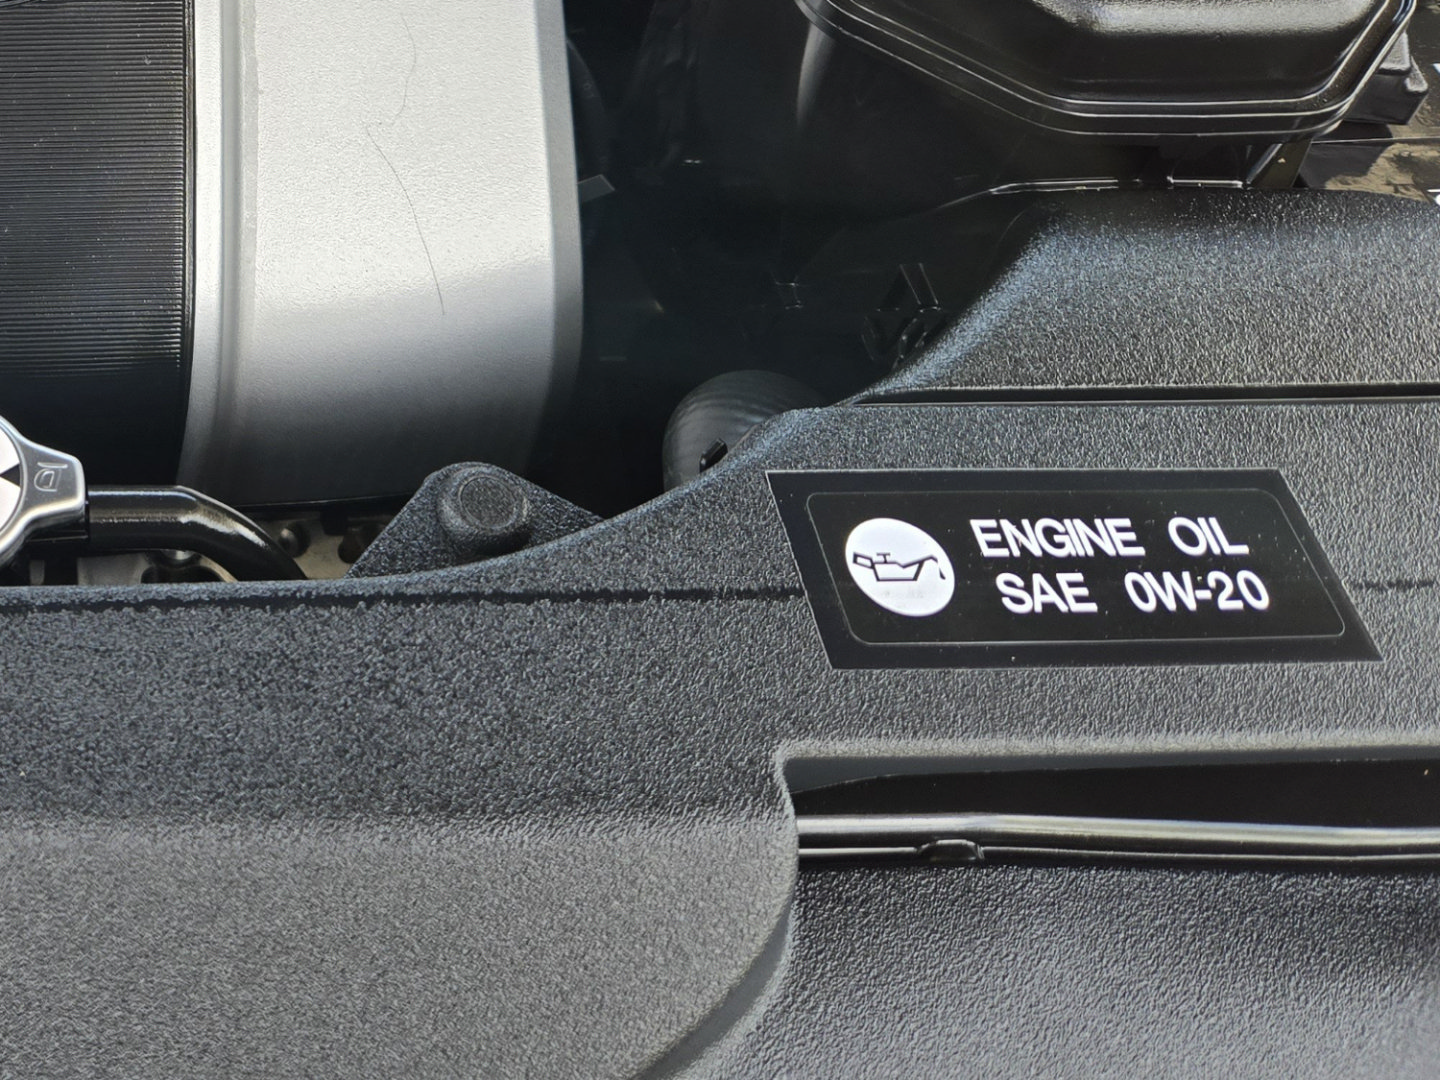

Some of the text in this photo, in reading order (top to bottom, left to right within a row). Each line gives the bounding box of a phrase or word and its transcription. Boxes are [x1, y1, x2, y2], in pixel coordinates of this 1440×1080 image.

[970, 517, 1249, 557] ENGINE OIL
[996, 571, 1269, 613] SAE 0W-20
